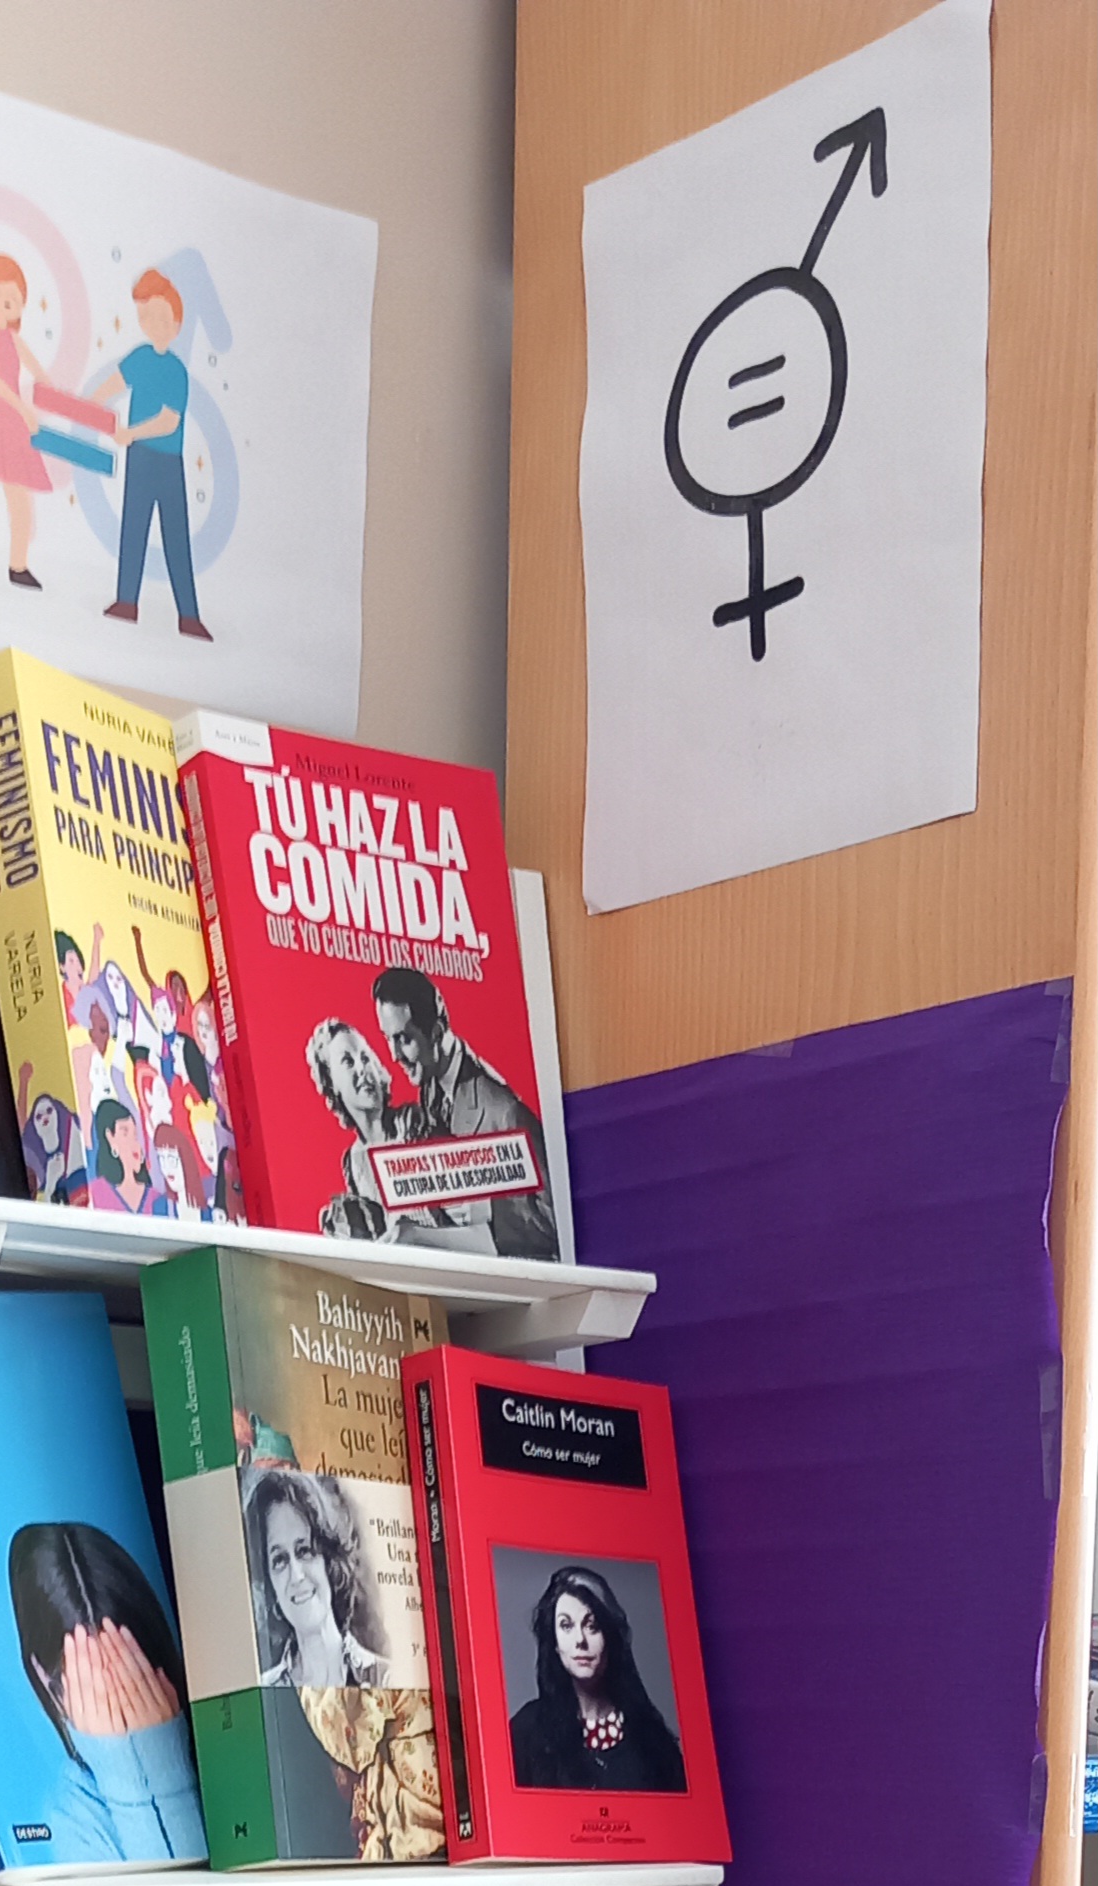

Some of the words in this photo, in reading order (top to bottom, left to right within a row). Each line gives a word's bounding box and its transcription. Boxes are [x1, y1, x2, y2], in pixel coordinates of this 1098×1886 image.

[83, 701, 132, 735] NURIA
[294, 752, 350, 781] Miguel
[355, 764, 417, 794] Lorente
[53, 805, 108, 864] PARA
[243, 765, 308, 842] TÚ
[312, 781, 406, 861] HAZ
[408, 799, 469, 872] LA
[248, 830, 491, 960] COMIDA,
[266, 913, 299, 951] QUE
[297, 917, 321, 956] YO
[322, 923, 381, 967] CUELGO
[382, 935, 412, 970] LOS
[413, 942, 484, 983] CUADROS
[23, 930, 44, 1006] NURIA
[383, 1154, 431, 1178] TRAMPAS
[438, 1146, 497, 1171] TRAMPOSOS
[497, 1146, 510, 1162] EN
[509, 1141, 523, 1160] LA
[393, 1176, 436, 1197] CULTURA
[437, 1175, 450, 1192] DE
[450, 1173, 463, 1190] LA
[463, 1163, 526, 1187] DESIGUALDAD
[317, 1290, 404, 1345] Bahiyyih
[321, 1374, 348, 1409] La
[502, 1398, 556, 1430] Caitlin
[559, 1408, 615, 1438] Moran
[340, 1426, 375, 1457] que
[522, 1440, 553, 1460] Cómo
[555, 1447, 570, 1463] ser
[572, 1450, 601, 1468] mujer
[387, 1543, 411, 1563] Una
[377, 1566, 414, 1587] novela
